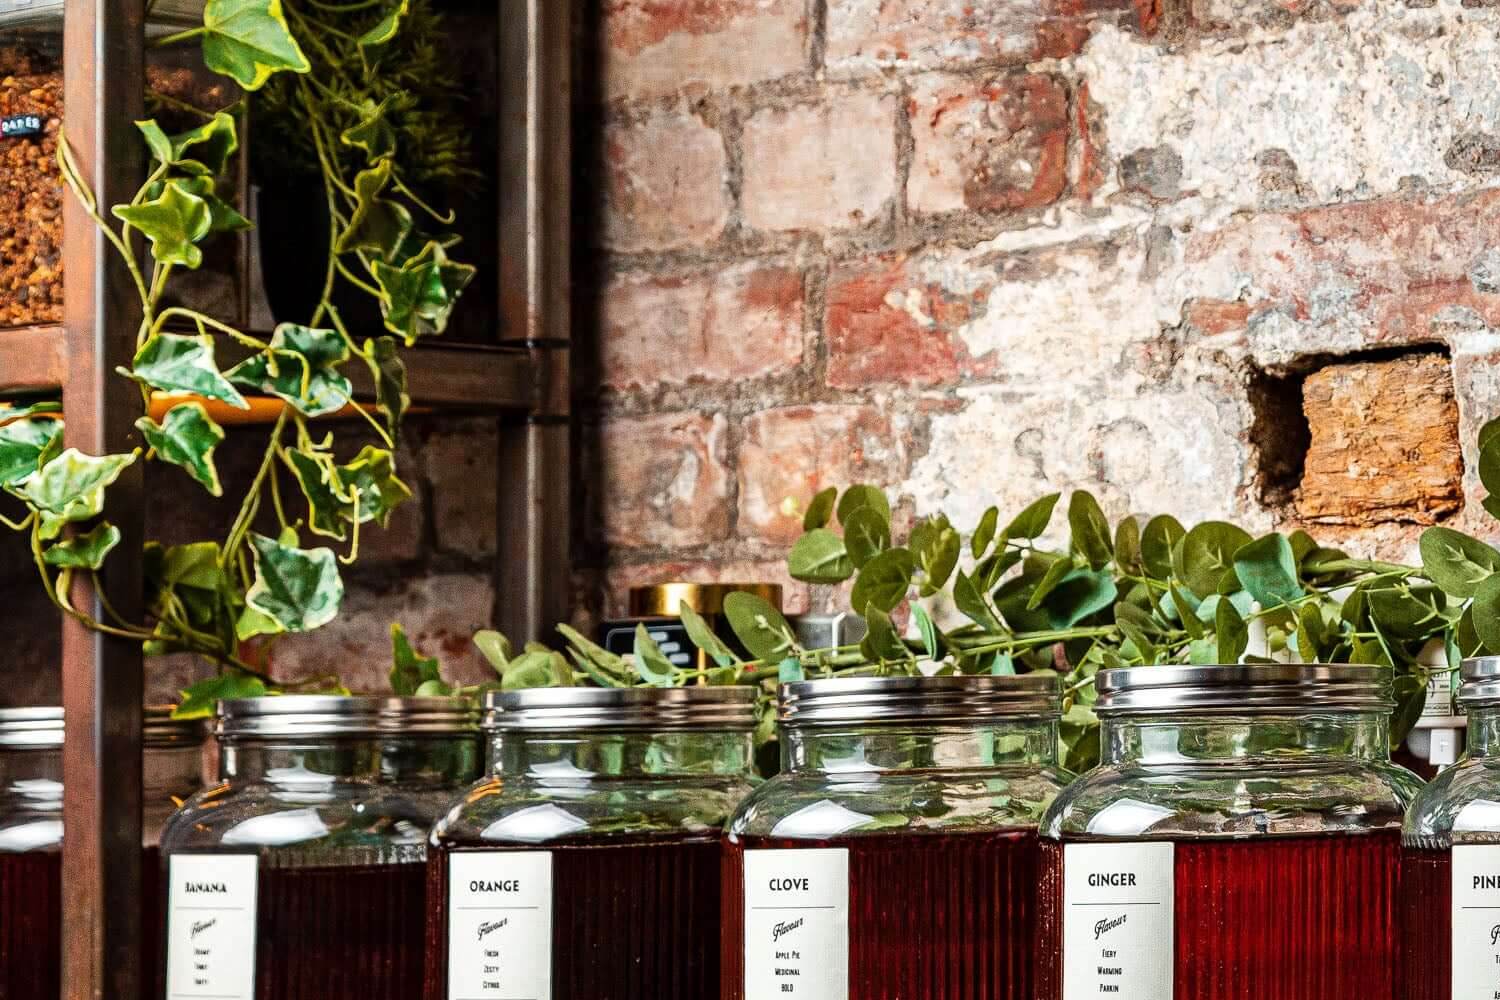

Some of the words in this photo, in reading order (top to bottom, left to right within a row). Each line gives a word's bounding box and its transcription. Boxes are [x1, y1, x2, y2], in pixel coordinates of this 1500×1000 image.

[470, 880, 520, 892] ORANGE
[769, 878, 809, 891] CLOVE
[1088, 873, 1136, 886] GINGER
[477, 918, 507, 940] Flavour
[772, 917, 803, 942] Flavour
[1094, 914, 1127, 940] Flavour
